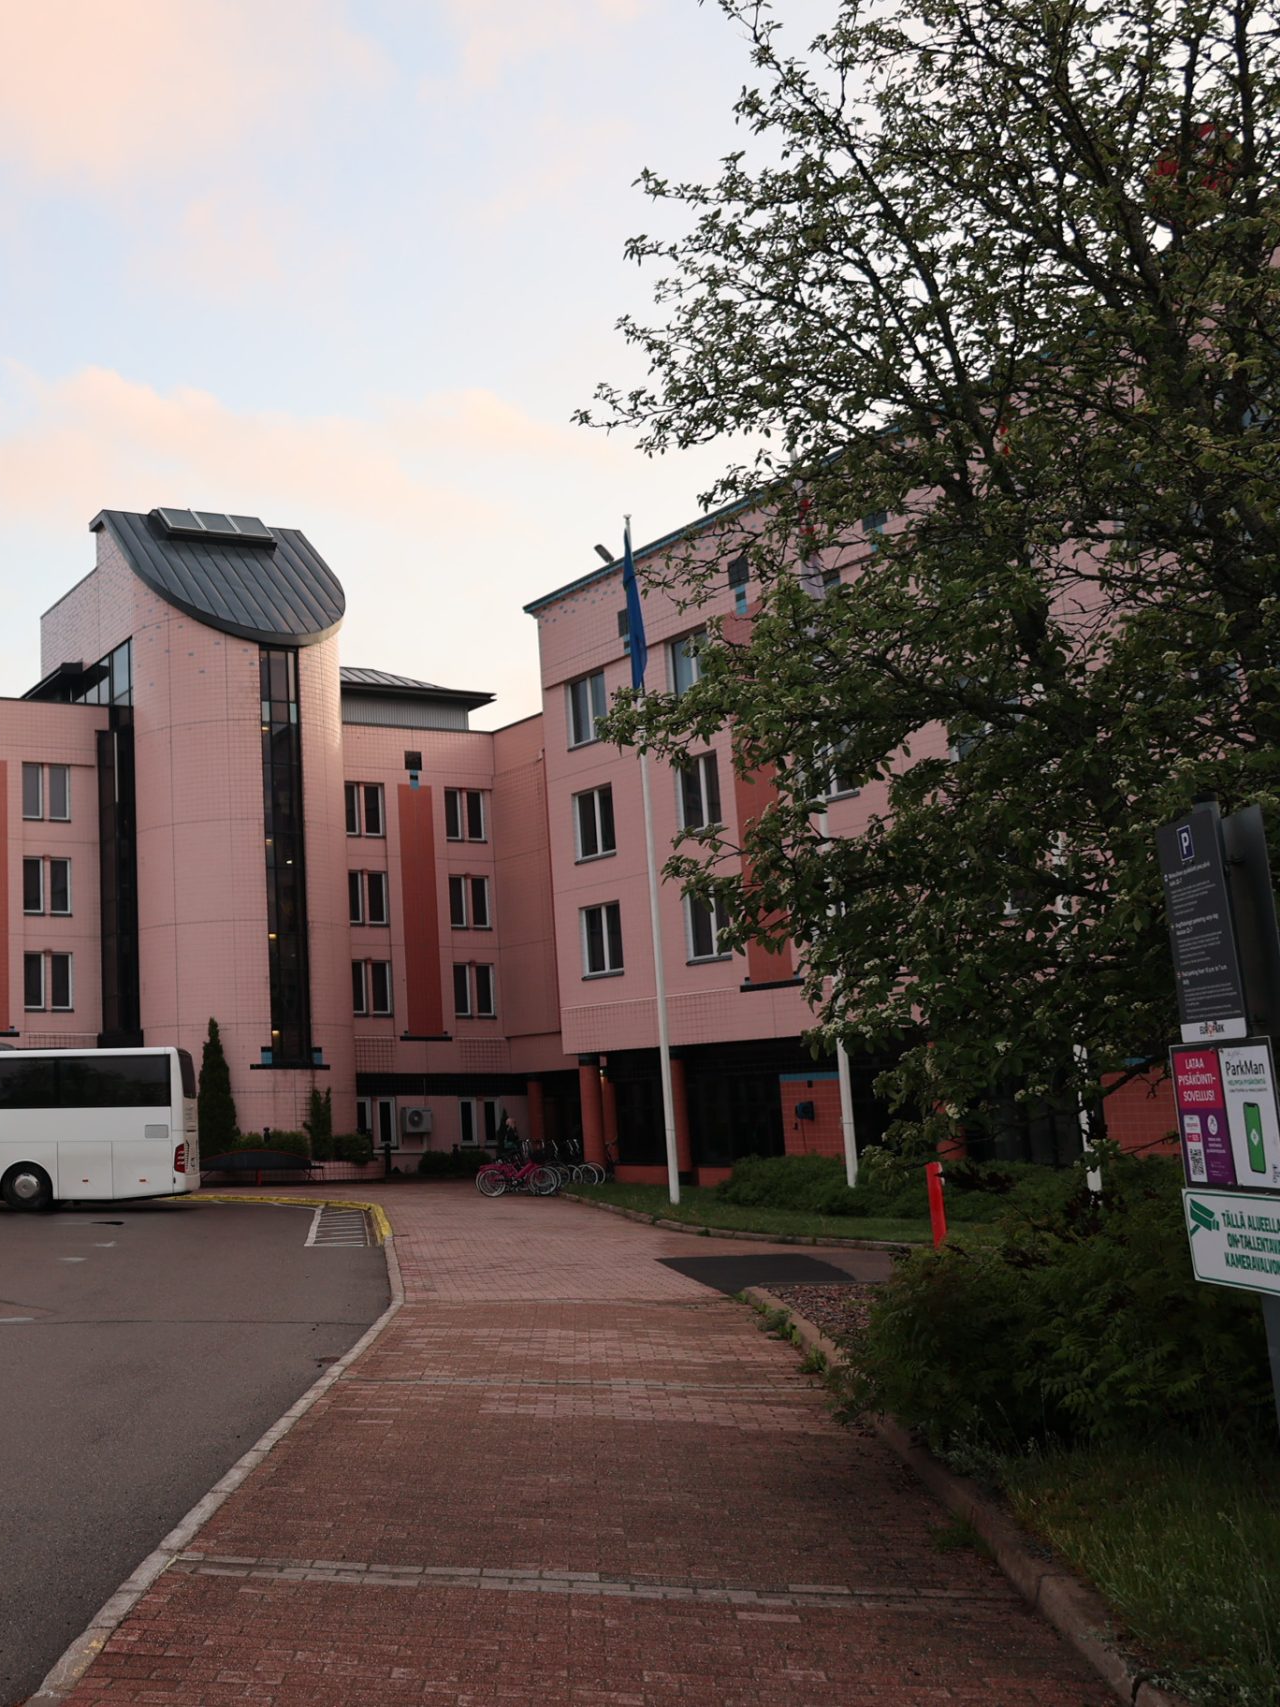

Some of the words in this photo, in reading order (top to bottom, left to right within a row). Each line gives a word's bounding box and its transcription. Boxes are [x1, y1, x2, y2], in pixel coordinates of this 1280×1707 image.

[1181, 831, 1189, 854] P
[1185, 1058, 1205, 1069] LATAA
[1225, 1060, 1265, 1076] ParkMan
[1221, 1209, 1246, 1229] TÄLLÄ
